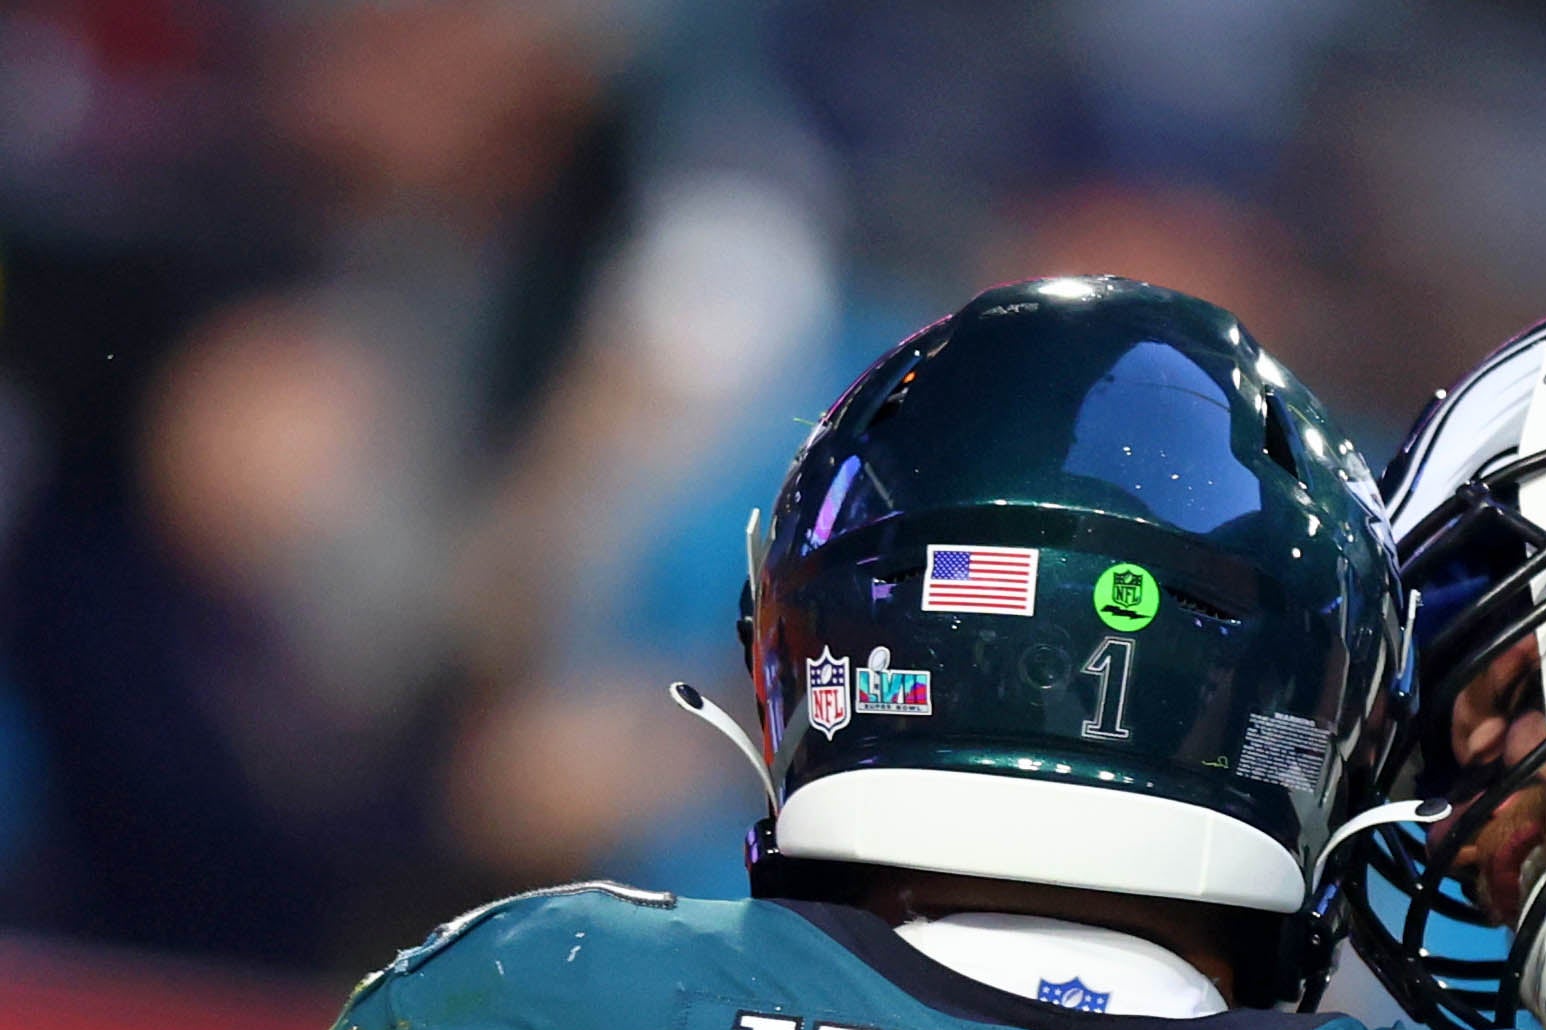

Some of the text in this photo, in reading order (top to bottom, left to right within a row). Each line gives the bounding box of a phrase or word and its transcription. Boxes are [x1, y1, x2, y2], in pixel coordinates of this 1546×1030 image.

[1115, 586, 1140, 604] NFL
[858, 671, 928, 705] LVII
[1080, 636, 1136, 740] 1
[813, 688, 845, 724] NFL
